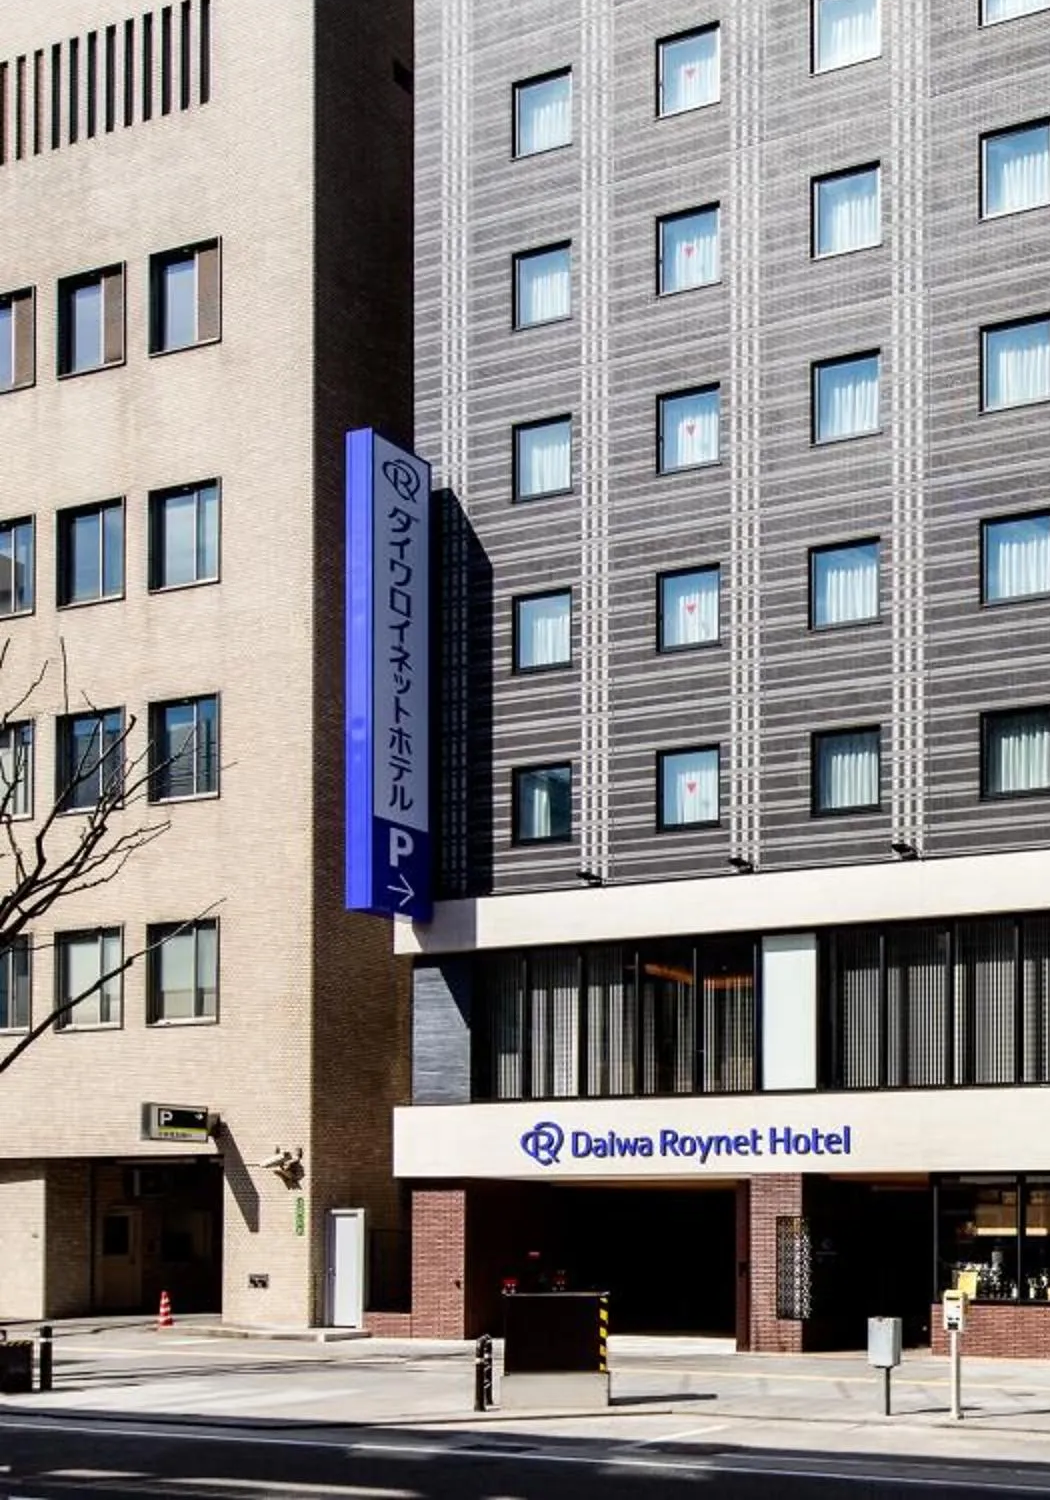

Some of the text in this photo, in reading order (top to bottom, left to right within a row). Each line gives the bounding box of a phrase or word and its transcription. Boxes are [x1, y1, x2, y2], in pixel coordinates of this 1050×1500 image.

[387, 506, 419, 812] ダイワロイネットホテル
[389, 827, 415, 868] P
[160, 1111, 173, 1125] P
[571, 1130, 653, 1159] Daiwa
[659, 1128, 764, 1164] Roynet
[769, 1125, 852, 1155] Hotel
